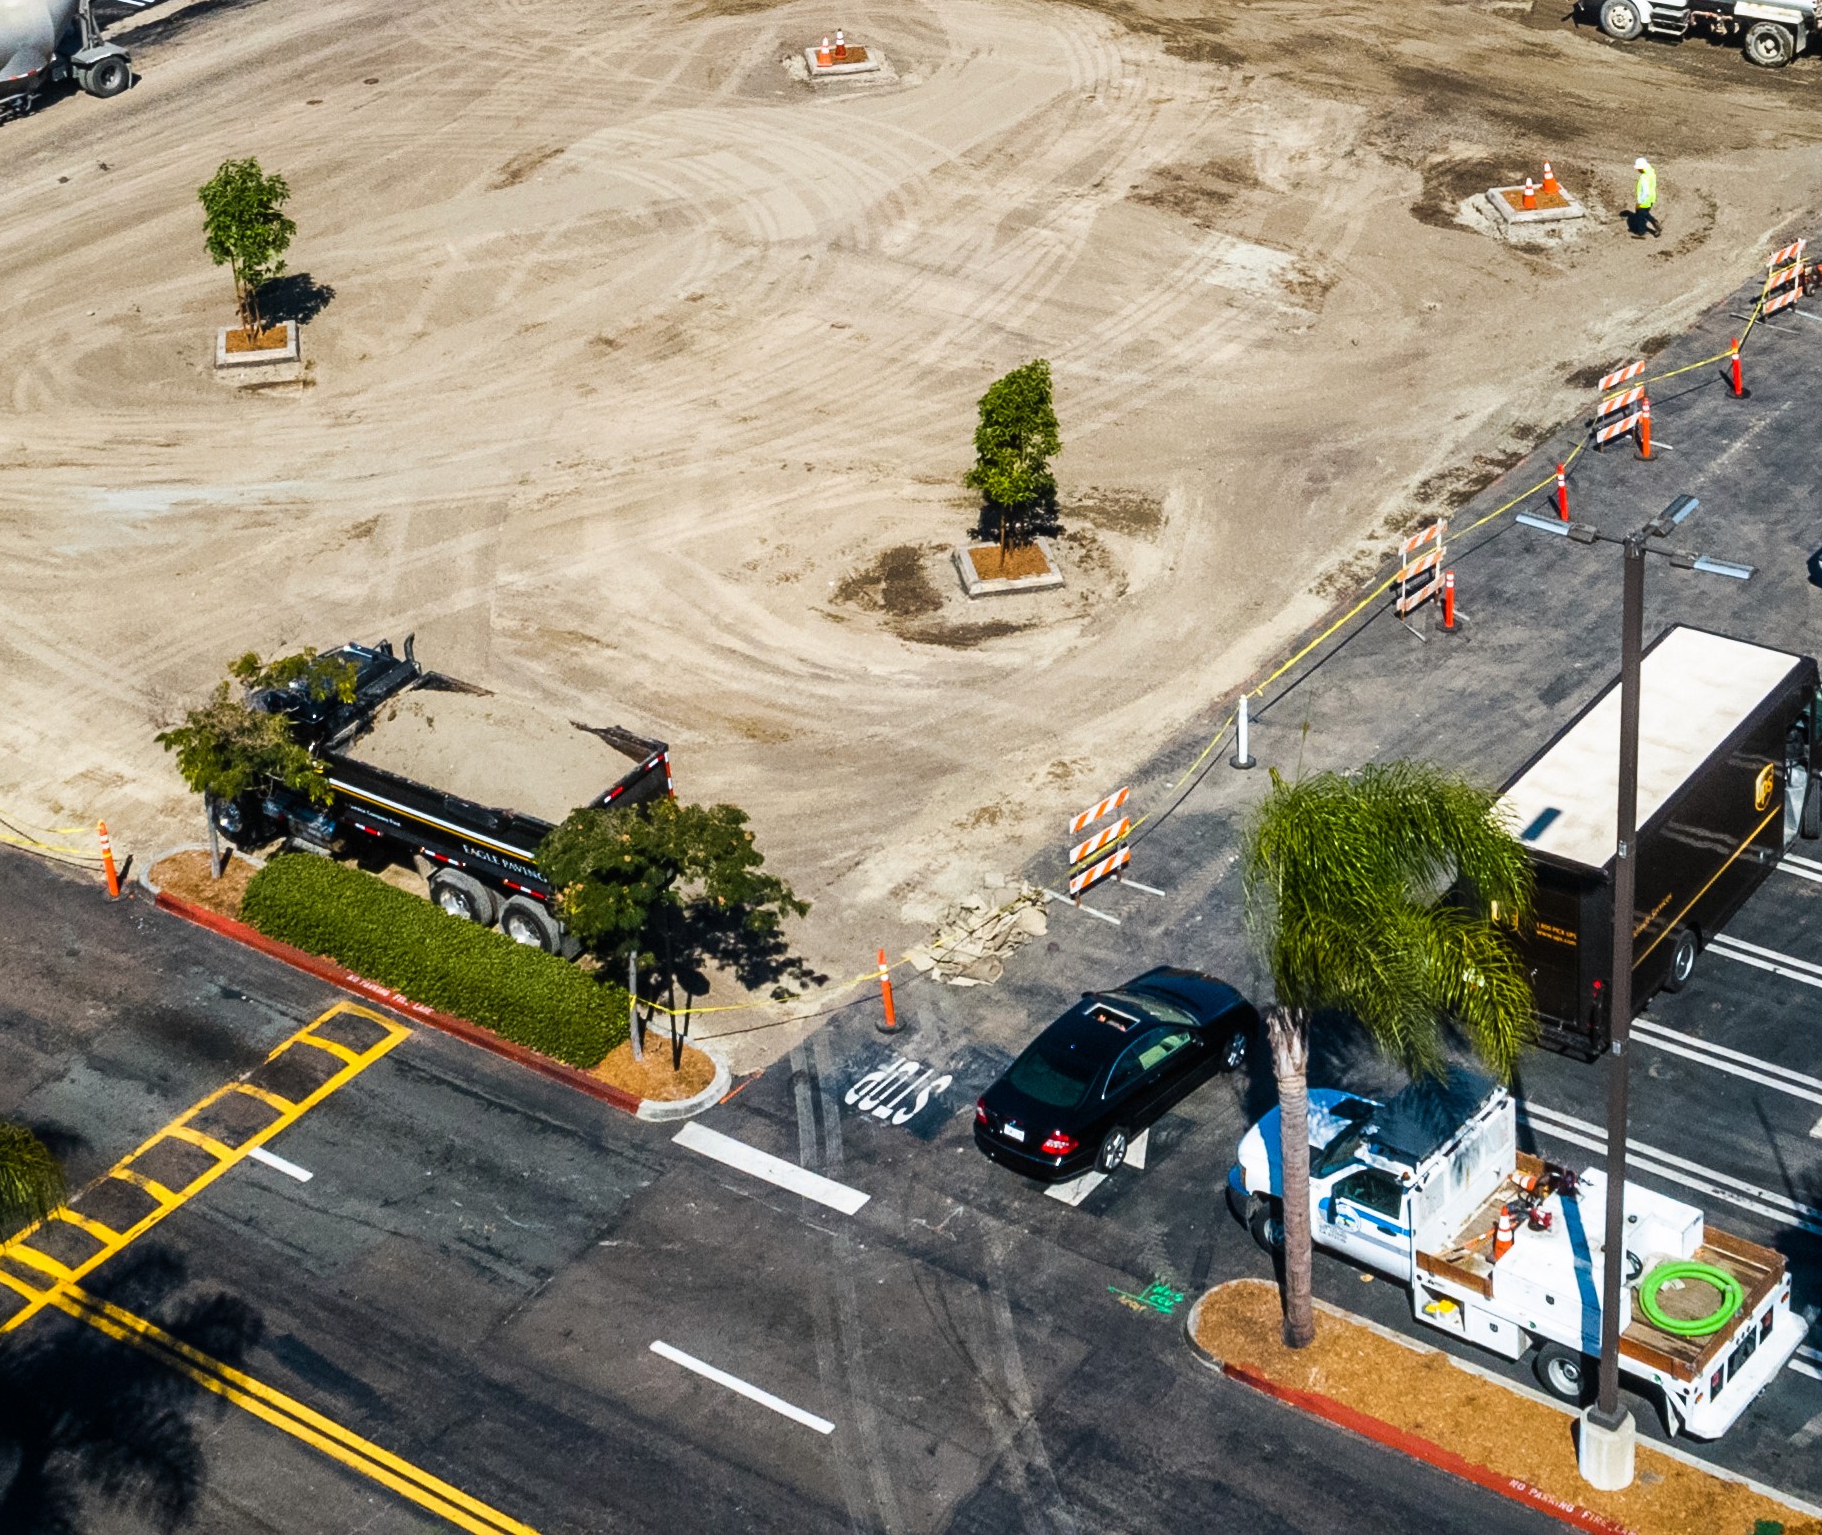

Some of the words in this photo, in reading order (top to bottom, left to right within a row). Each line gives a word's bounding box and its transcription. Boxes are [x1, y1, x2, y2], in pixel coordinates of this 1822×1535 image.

[462, 844, 500, 865] EAGLE
[501, 858, 548, 883] PAVING
[844, 1057, 953, 1125] STOP
[1508, 1478, 1527, 1491] NO
[1528, 1487, 1575, 1513] PARKING
